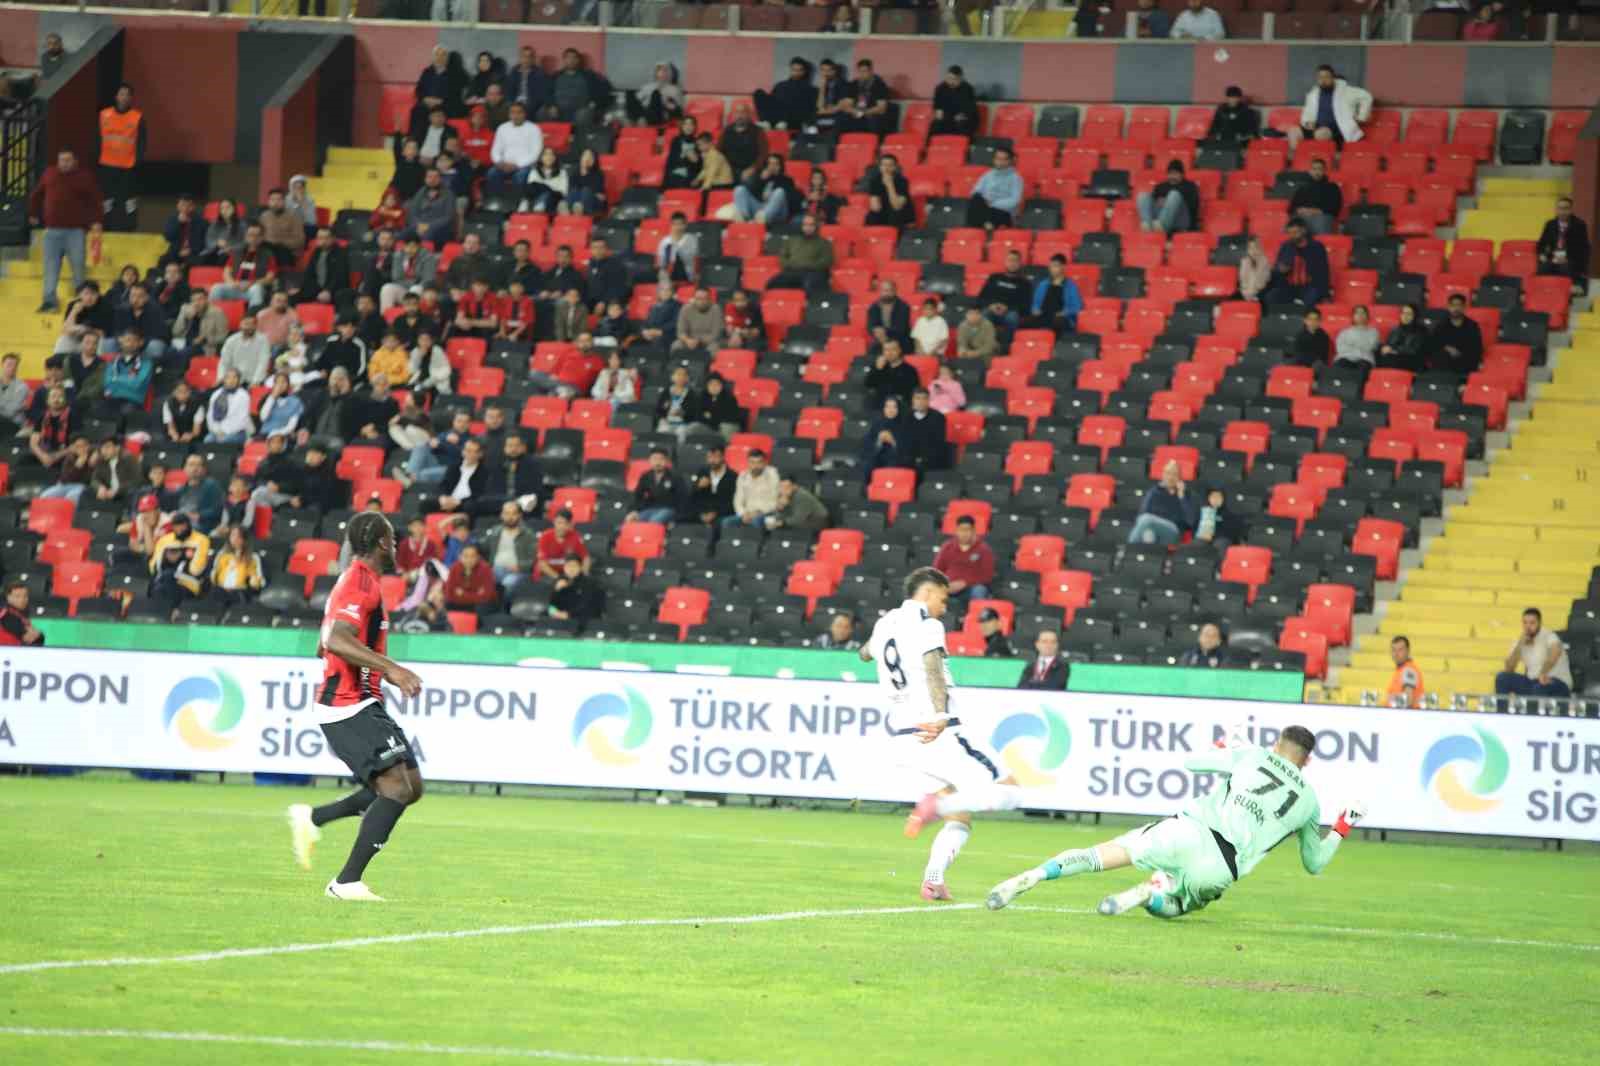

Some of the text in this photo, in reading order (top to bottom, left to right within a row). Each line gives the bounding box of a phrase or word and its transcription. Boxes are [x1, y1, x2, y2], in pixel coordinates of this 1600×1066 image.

[2, 660, 129, 704] İPPON
[260, 671, 322, 712] TÜ
[669, 689, 895, 737] TÜRK NİPP
[668, 735, 837, 782] SİGORTA
[1088, 708, 1380, 764] TÜRK İPON
[1527, 731, 1600, 775] TÜR
[1087, 756, 1222, 800] SİGOR
[1246, 766, 1300, 819] 71
